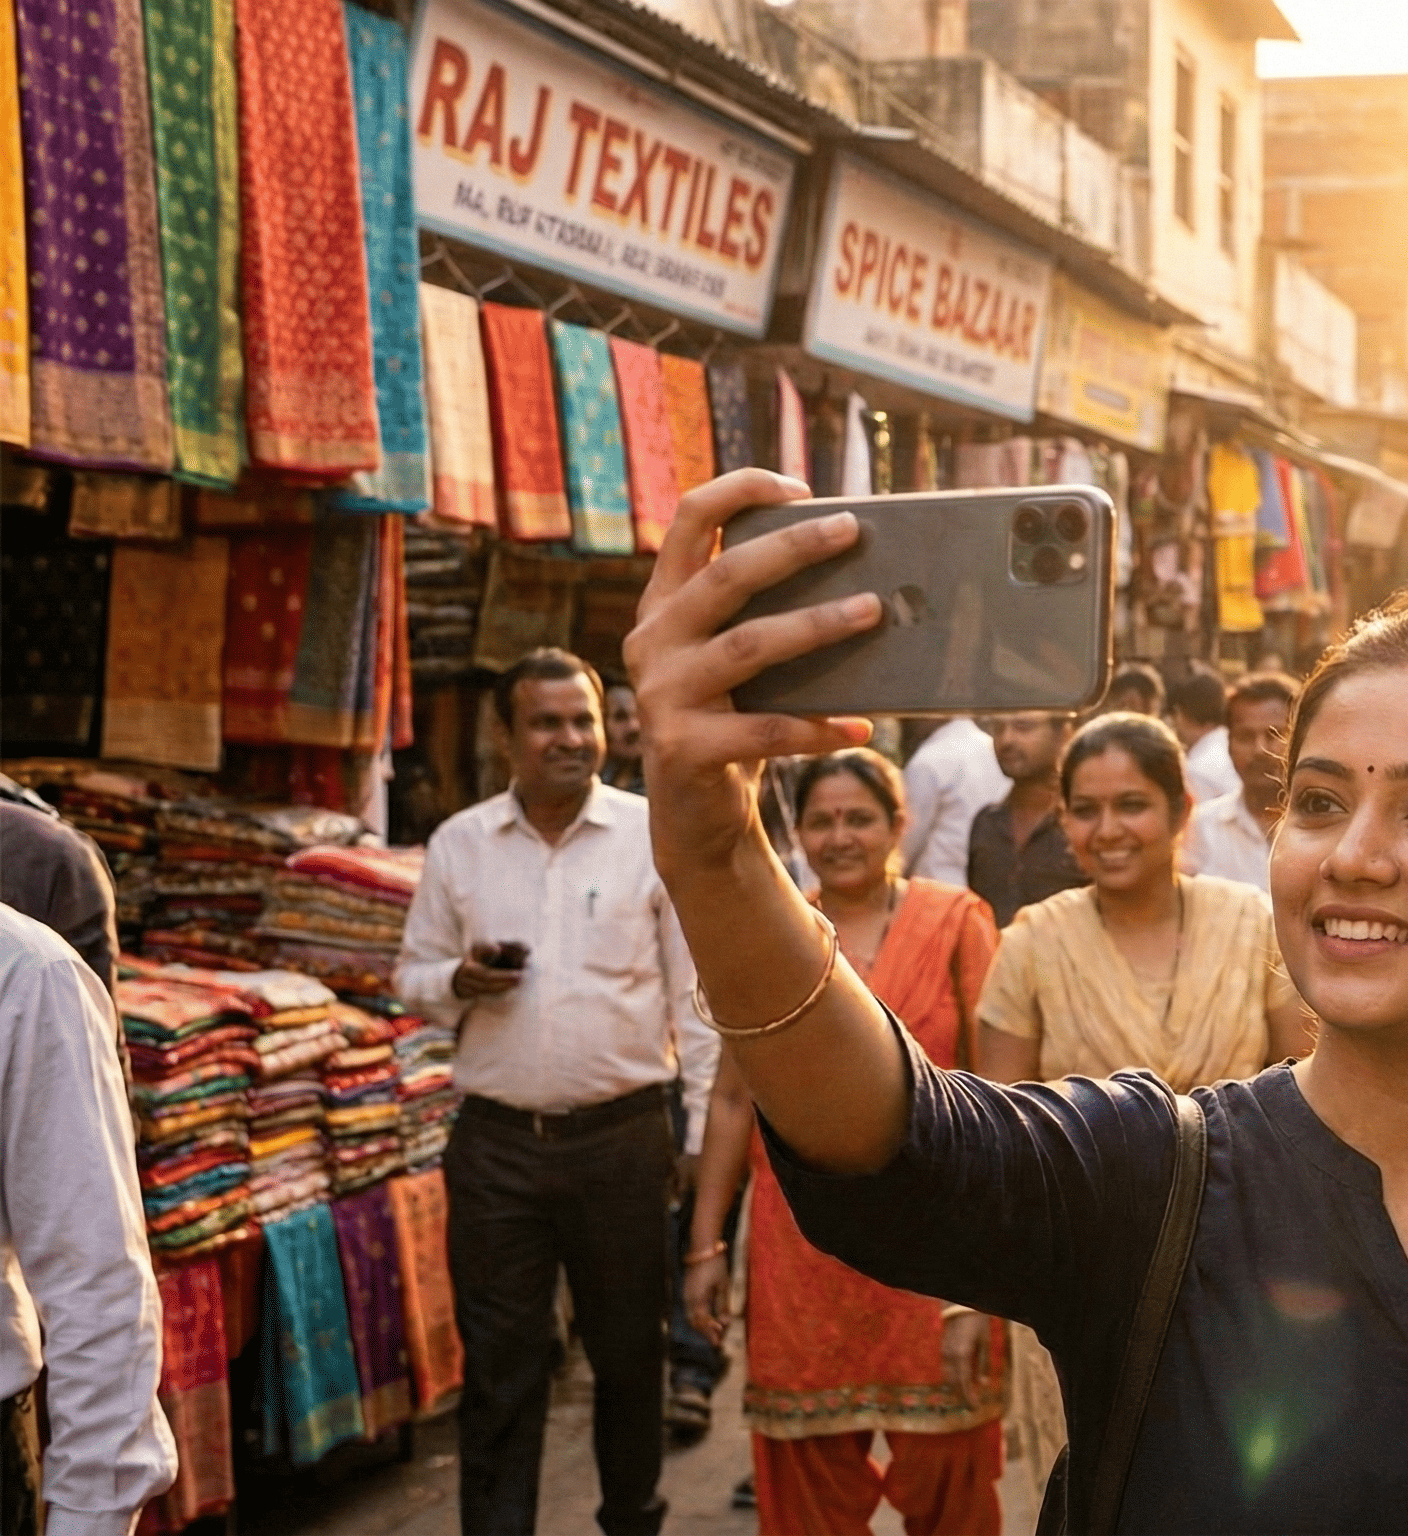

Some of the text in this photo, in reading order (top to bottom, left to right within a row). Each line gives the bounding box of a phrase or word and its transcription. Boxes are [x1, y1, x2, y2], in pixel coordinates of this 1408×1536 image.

[416, 36, 552, 181] RAJ
[565, 99, 774, 273] TEXTILES
[833, 221, 929, 323] SPICE
[931, 263, 1037, 364] BAZAAR
